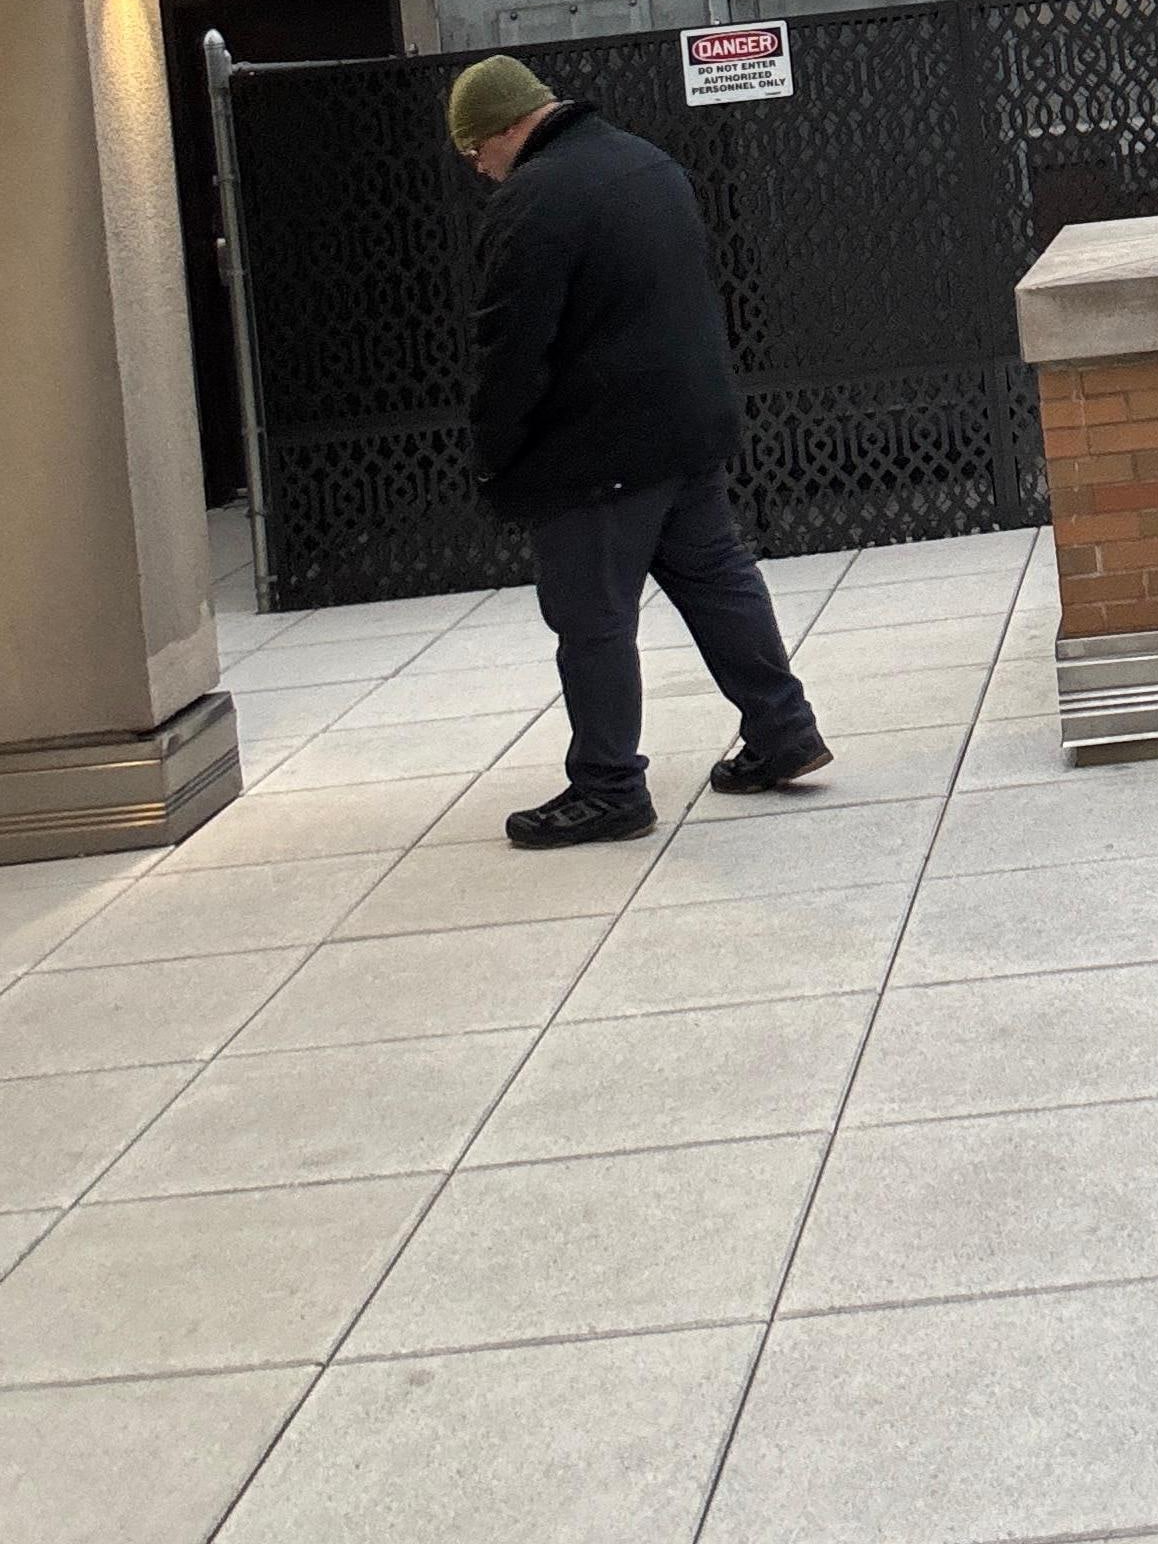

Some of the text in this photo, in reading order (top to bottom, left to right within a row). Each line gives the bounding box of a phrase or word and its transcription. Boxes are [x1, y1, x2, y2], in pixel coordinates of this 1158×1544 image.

[698, 35, 772, 57] DANGER
[698, 60, 776, 75] DO NOT ENTER
[704, 71, 772, 84] AUTHORIZED
[692, 82, 756, 95] PERSONNEL
[758, 78, 786, 88] ONLY
